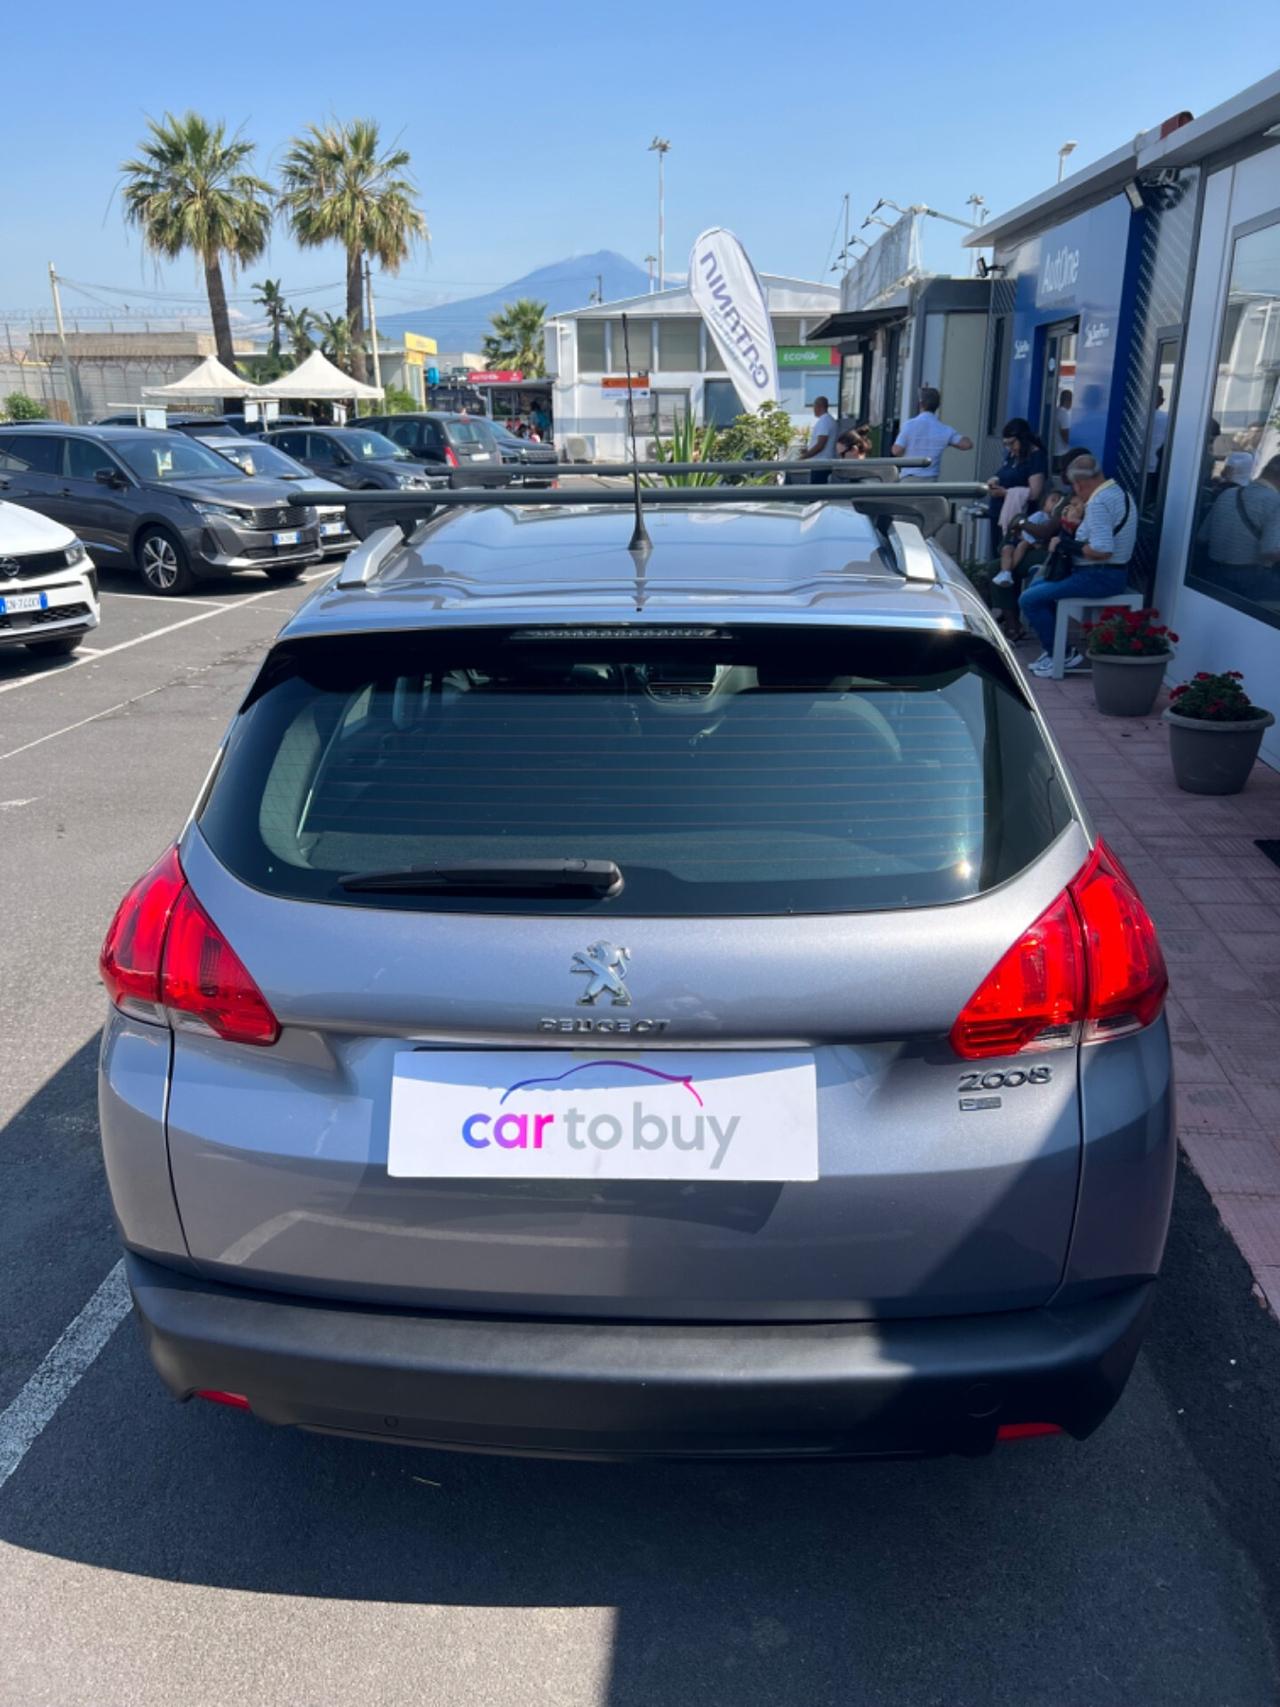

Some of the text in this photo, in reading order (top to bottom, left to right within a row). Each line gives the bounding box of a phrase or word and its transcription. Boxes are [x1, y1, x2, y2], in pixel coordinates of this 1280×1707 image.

[540, 1018, 671, 1032] PEUGEOT
[958, 1065, 1052, 1092] 2008
[462, 1101, 741, 1170] car to buy
